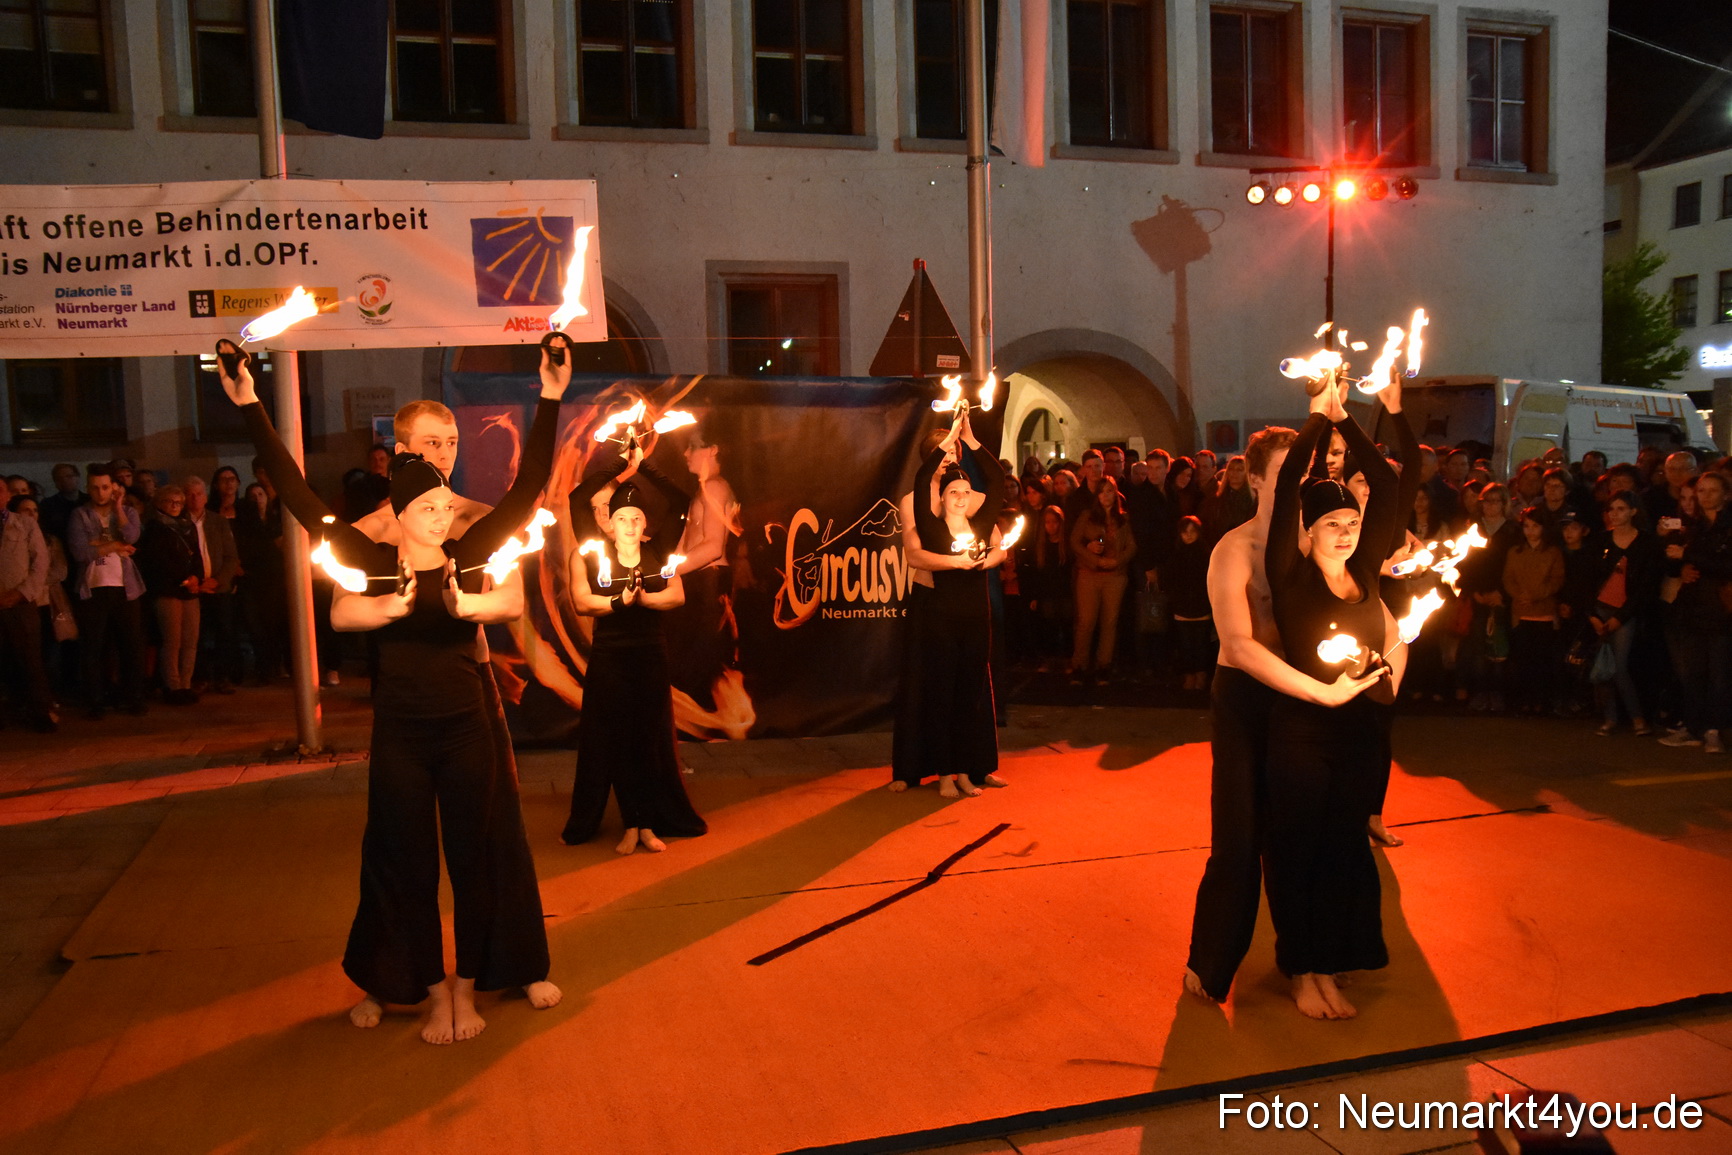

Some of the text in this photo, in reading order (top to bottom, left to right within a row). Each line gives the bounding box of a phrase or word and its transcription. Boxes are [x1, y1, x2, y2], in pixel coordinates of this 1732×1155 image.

[0, 206, 429, 240] ft offene Behindertenarbeit
[2, 241, 319, 275] is Neumarkt i.d.OPf.
[55, 284, 117, 299] Diakonie
[55, 299, 176, 316] Nürnberger Land
[221, 294, 270, 313] Regens
[23, 317, 46, 329] e.V.
[57, 317, 128, 330] Neumarkt
[822, 606, 898, 619] Neumarkt
